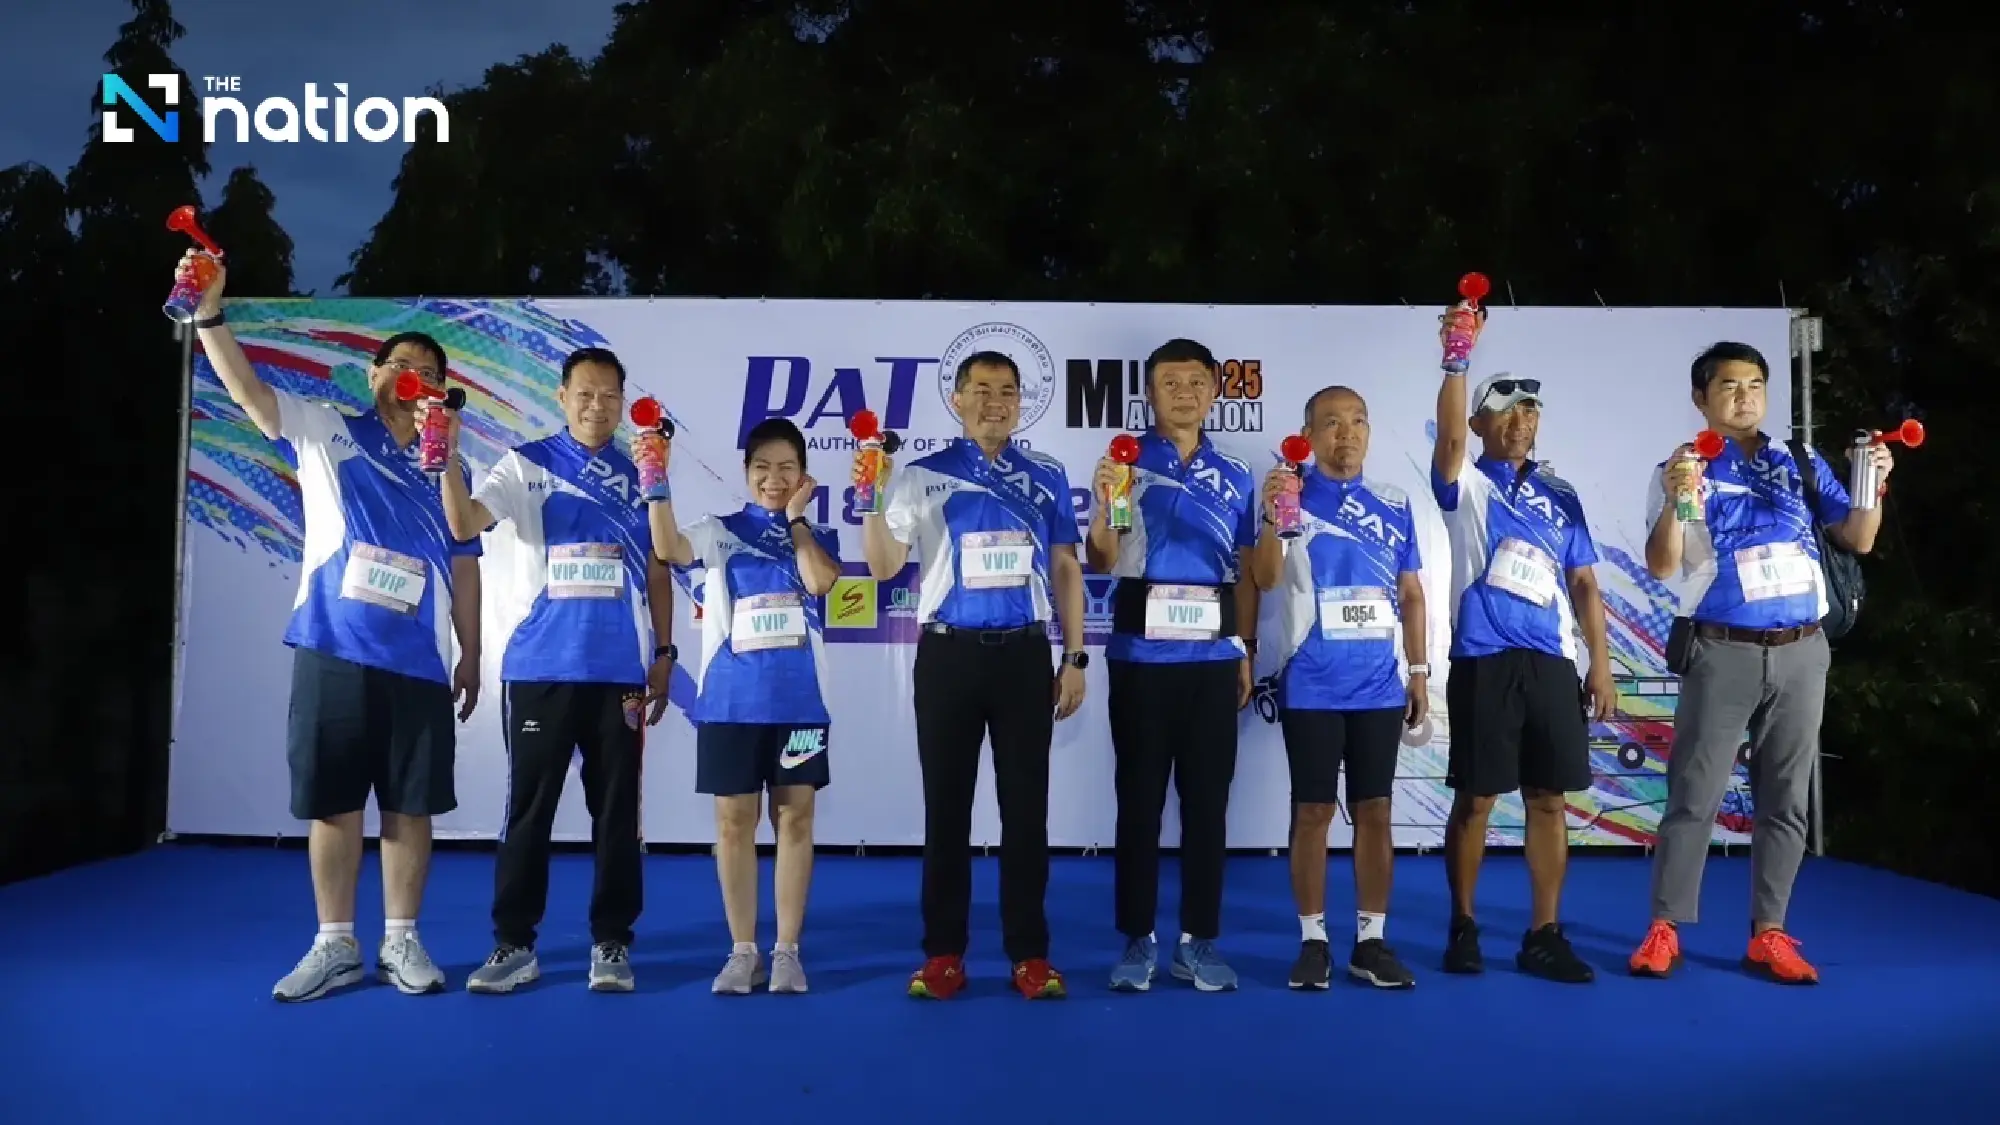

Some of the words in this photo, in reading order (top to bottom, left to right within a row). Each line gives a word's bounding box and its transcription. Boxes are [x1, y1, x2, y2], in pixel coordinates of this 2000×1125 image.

[737, 356, 940, 450] PAT
[913, 437, 936, 451] OF
[1342, 495, 1406, 547] PAT
[982, 552, 1018, 571] VVIP
[368, 567, 406, 593] VVIP
[552, 564, 578, 580] VIP
[582, 564, 616, 580] 0023
[752, 613, 788, 633] VVIP
[1168, 605, 1203, 623] VVIP
[1342, 605, 1377, 622] 0354
